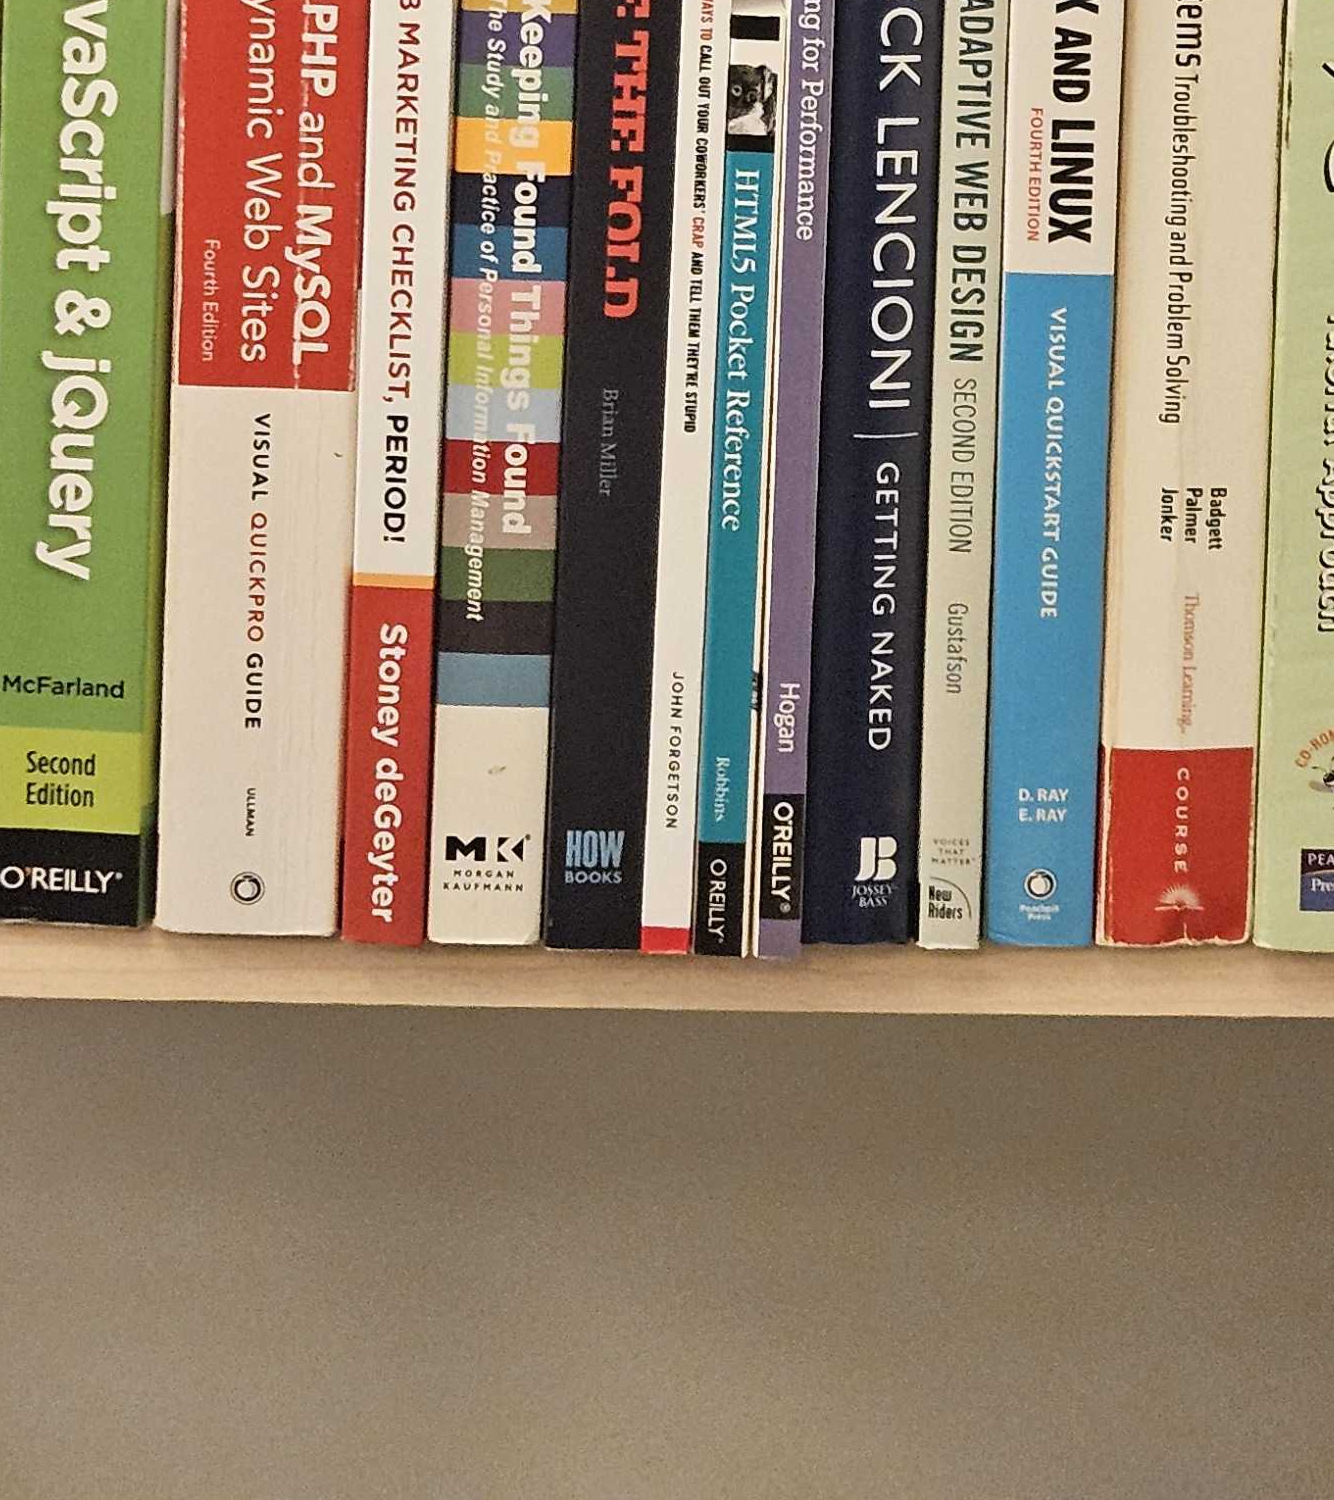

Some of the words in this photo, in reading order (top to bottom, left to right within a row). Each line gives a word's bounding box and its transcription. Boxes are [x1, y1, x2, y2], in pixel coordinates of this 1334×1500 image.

[301, 0, 338, 96] PHP
[802, 46, 819, 72] for
[1051, 27, 1099, 103] AND
[298, 112, 335, 188] and
[394, 23, 420, 211] MARKETING
[797, 79, 824, 240] Performance
[1165, 74, 1198, 225] Troubleshooting
[244, 153, 283, 249] Web
[731, 169, 759, 273] HTML5
[954, 161, 989, 230] WEB
[1048, 120, 1095, 243] LINUX
[285, 203, 334, 366] MySQL
[869, 118, 919, 408] LENCIONI
[1170, 231, 1193, 266] and
[55, 290, 111, 335] &
[241, 266, 280, 361] Sites
[383, 224, 414, 402] CHECKLIST,
[728, 283, 754, 380] Pocket
[950, 245, 986, 361] DESIGN
[1167, 272, 1192, 349] Problem
[1048, 308, 1067, 390] VISUAL
[1159, 356, 1190, 423] Solving
[252, 414, 270, 500] VISUAL
[722, 389, 750, 531] Reference
[952, 379, 976, 462] SECOND
[36, 351, 111, 580] jQuery
[384, 416, 408, 542] PERIOD!
[1043, 397, 1064, 541] QUICKSTART
[873, 463, 899, 615] GETTING
[949, 472, 974, 552] EDITION
[1161, 488, 1179, 541] Jonker
[1185, 488, 1203, 543] Palmer
[1206, 488, 1227, 549] Badgett
[248, 513, 267, 641] QUICKPRO
[1041, 547, 1058, 618] GUIDE
[3, 675, 124, 698] McFarland
[245, 653, 263, 728] GUIDE
[371, 624, 407, 746] Stoney
[869, 632, 894, 750] NAKED
[946, 604, 968, 693] Gustafson
[671, 672, 684, 718] JOHN
[774, 683, 800, 752] Hogan
[26, 782, 93, 807] Edition
[27, 751, 95, 776] Second
[666, 726, 681, 828] FORGETSON
[0, 866, 114, 893] O'REILLY
[368, 758, 403, 922] deGeyter
[565, 871, 622, 883] BOOKS
[566, 830, 624, 868] HOW
